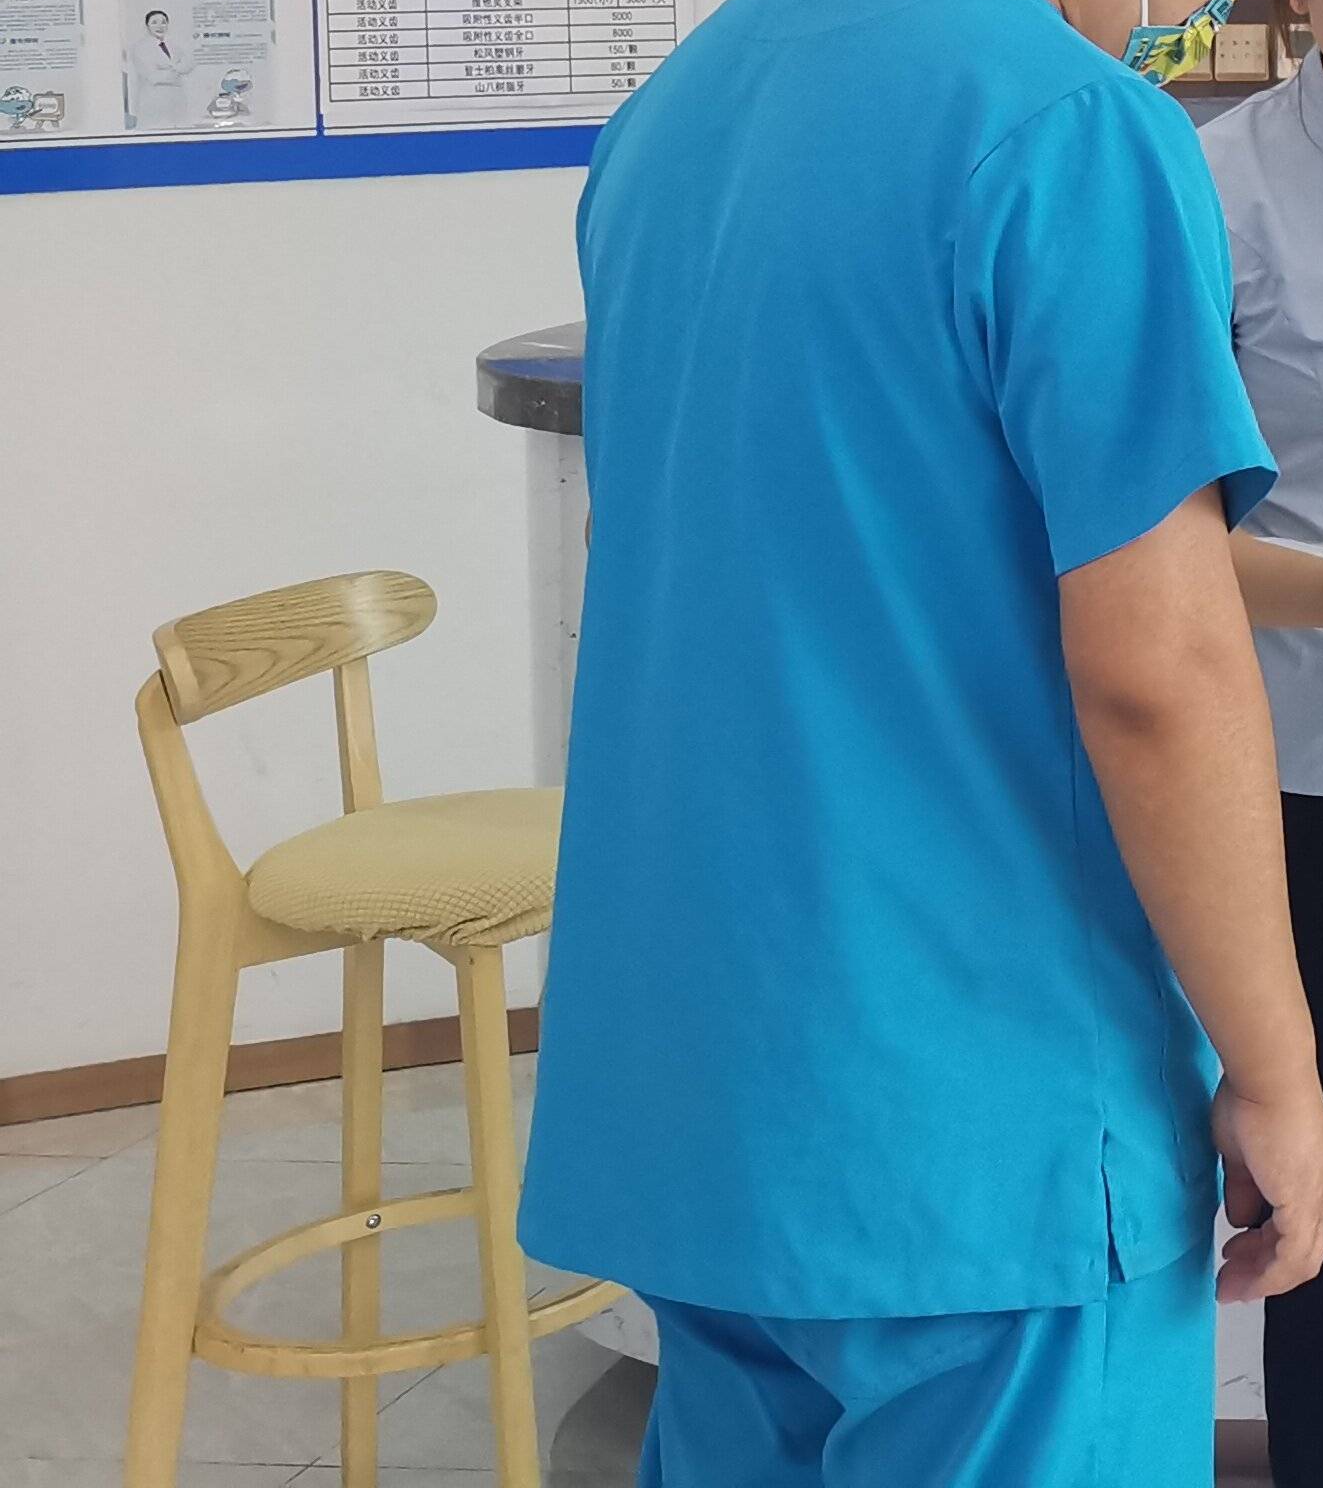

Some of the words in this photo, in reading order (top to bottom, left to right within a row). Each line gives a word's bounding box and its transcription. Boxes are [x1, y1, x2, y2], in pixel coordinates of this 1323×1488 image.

[357, 0, 397, 10] 活动义齿
[357, 16, 398, 27] 活动义齿
[358, 33, 398, 45] 活动义齿
[358, 51, 399, 62] 活动义齿
[359, 68, 400, 79] 活动义齿
[360, 85, 400, 97] 活动义齿
